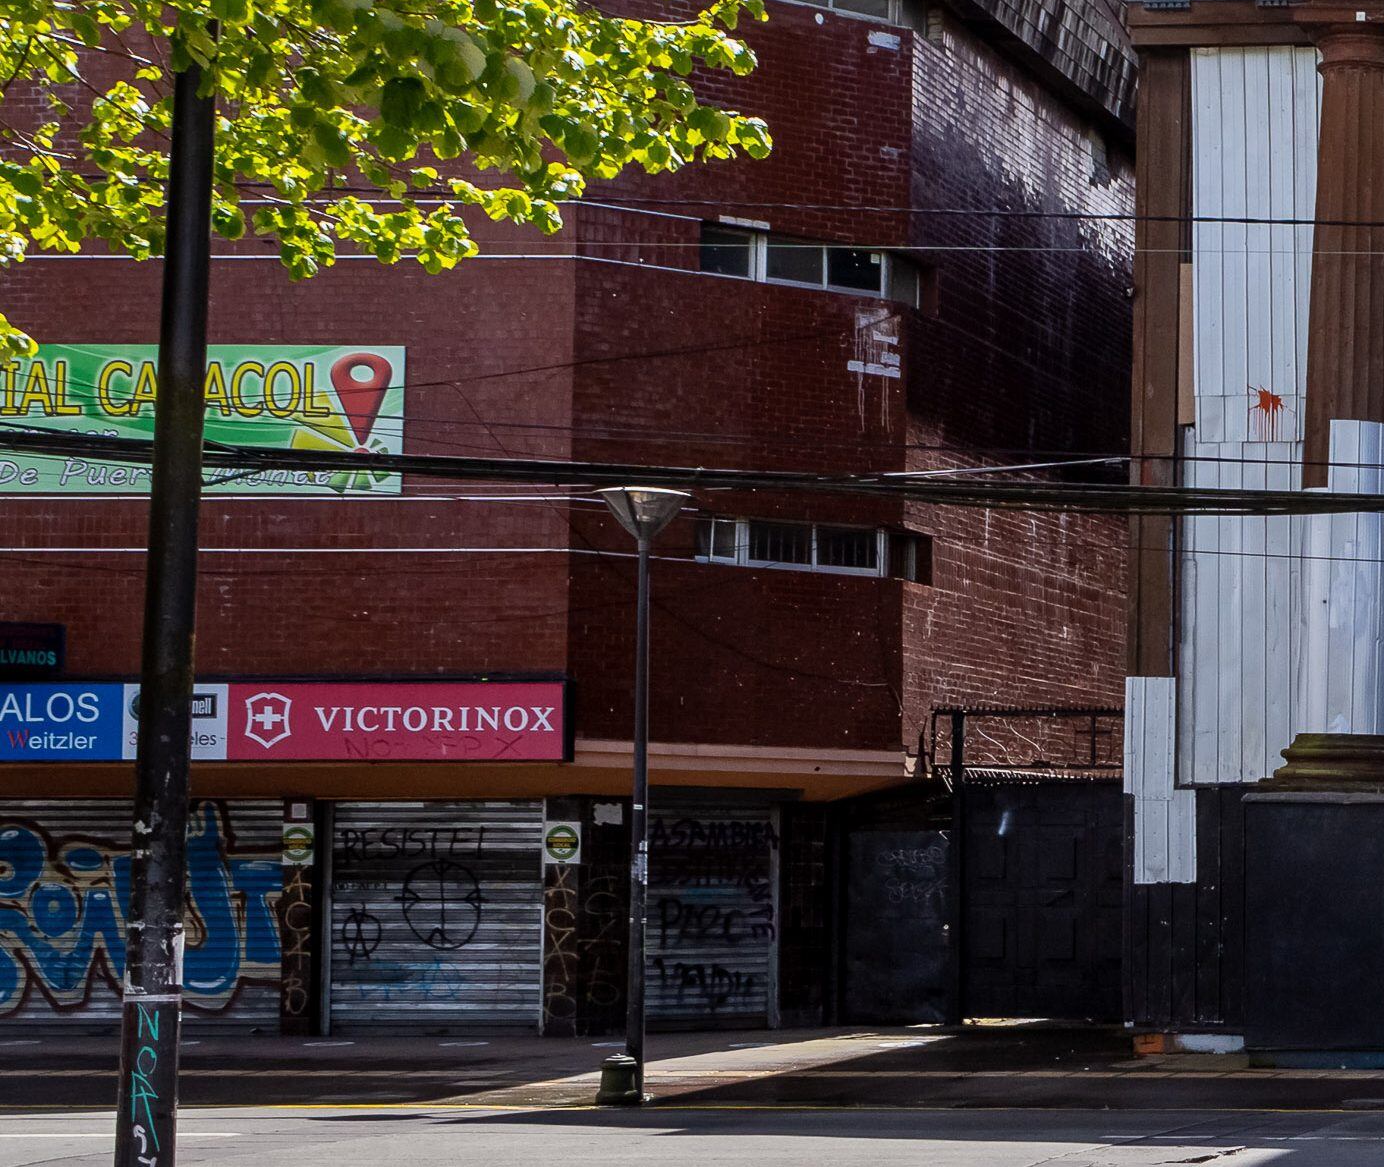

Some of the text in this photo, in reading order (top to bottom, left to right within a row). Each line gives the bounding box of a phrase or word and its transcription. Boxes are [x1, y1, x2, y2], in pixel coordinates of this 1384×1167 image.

[99, 360, 331, 418] CAACOL
[0, 693, 99, 723] ALOS
[314, 706, 555, 732] VICTORINOX
[6, 731, 98, 750] Weitzler
